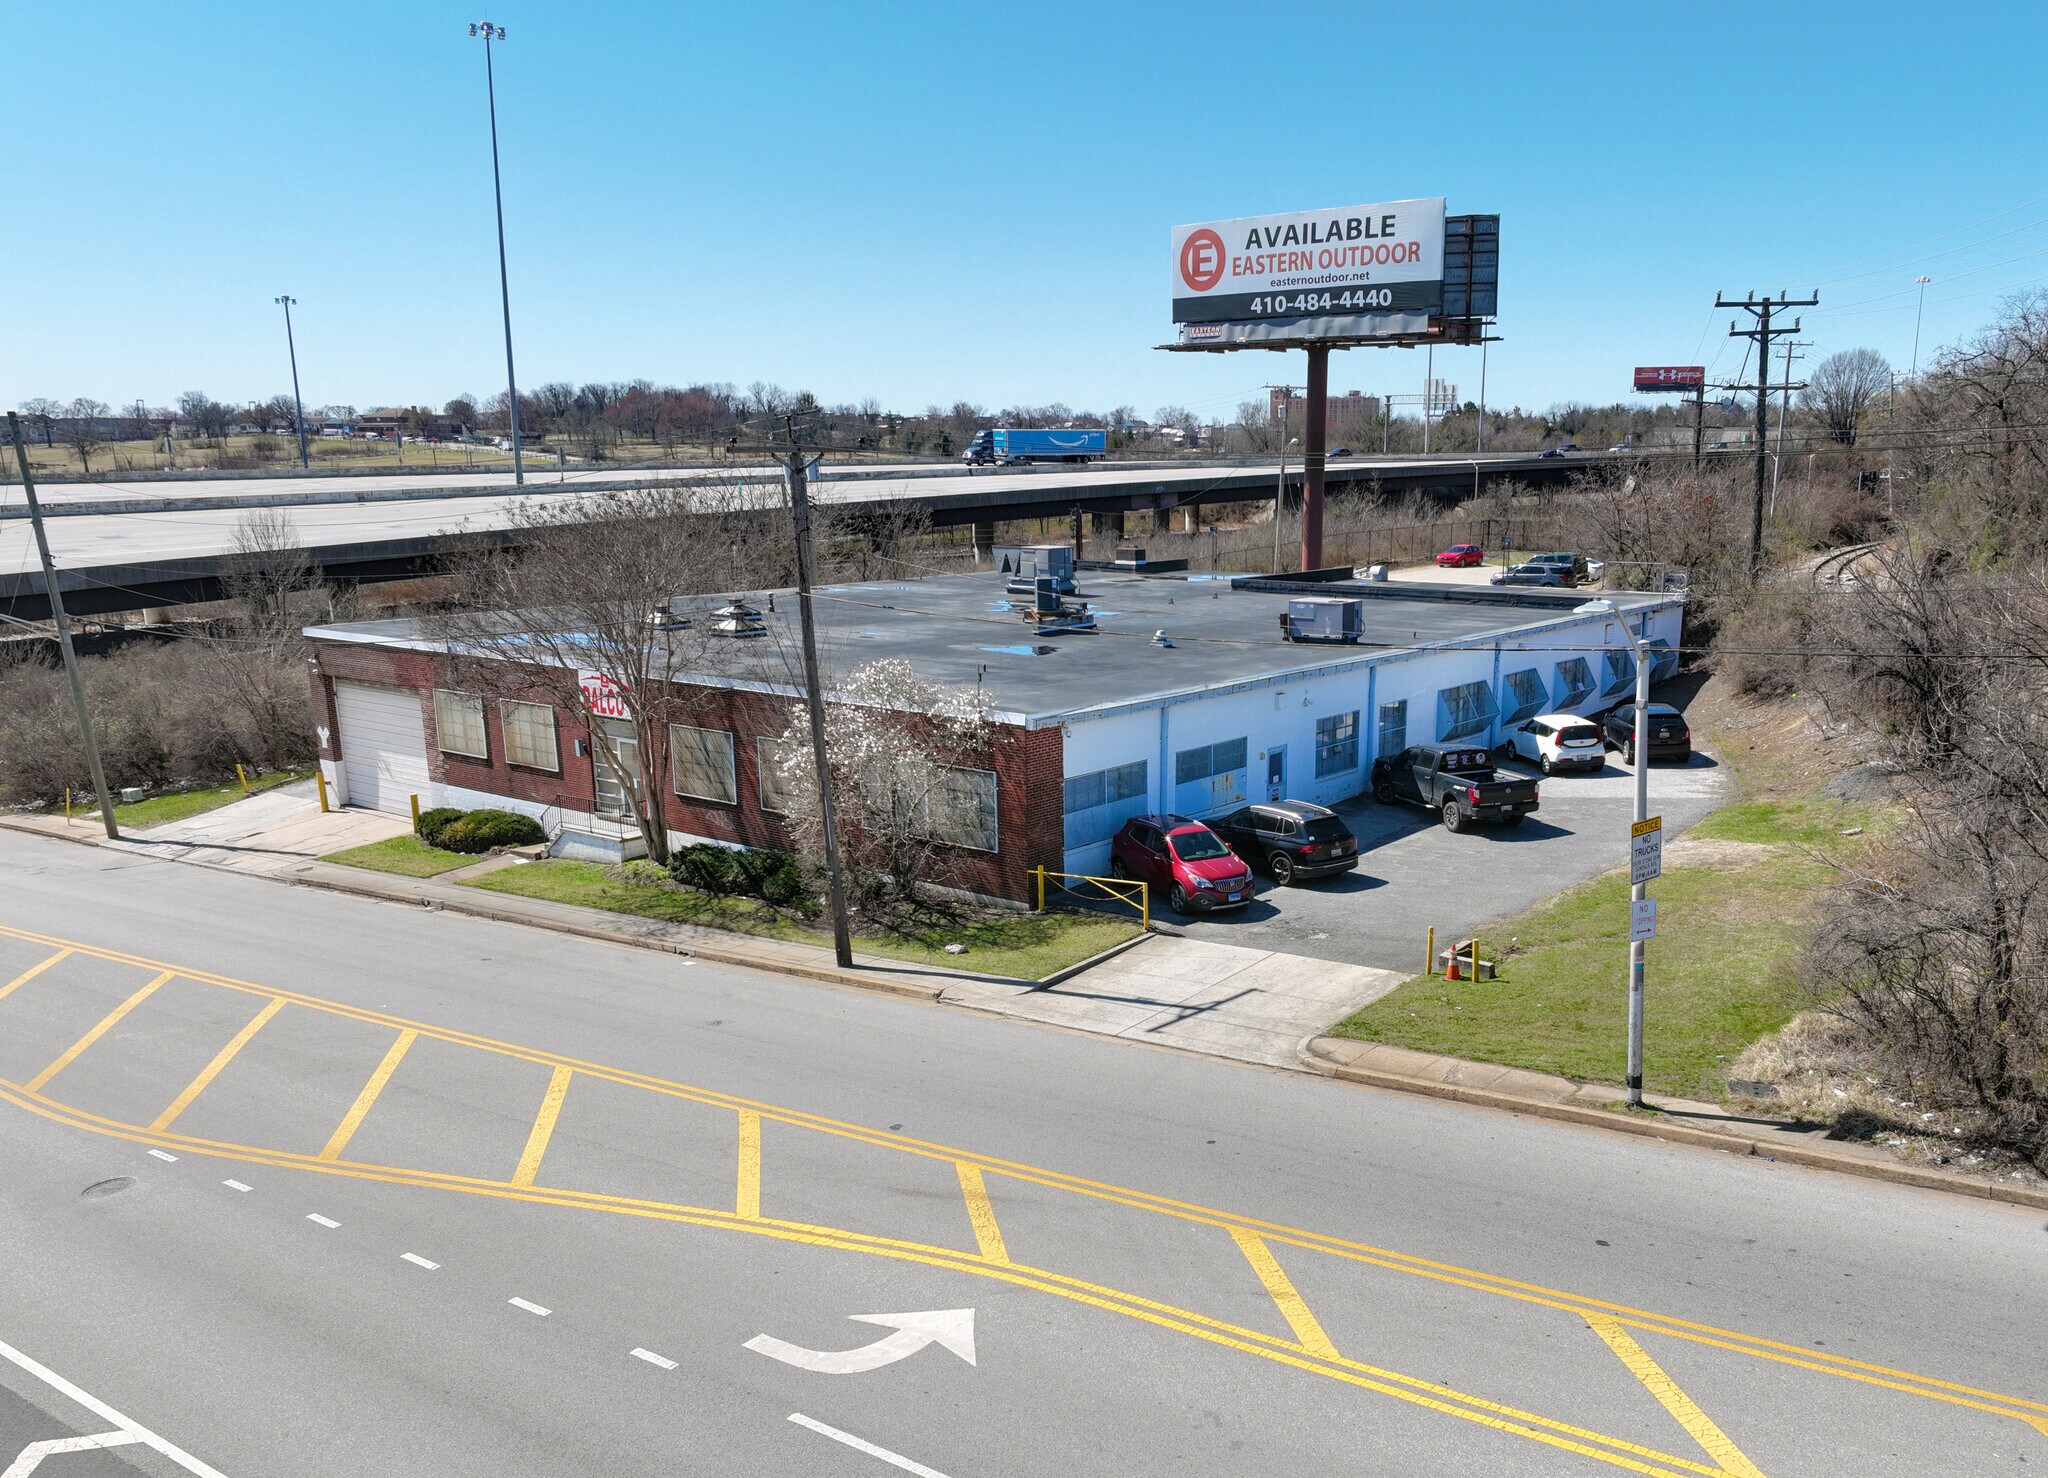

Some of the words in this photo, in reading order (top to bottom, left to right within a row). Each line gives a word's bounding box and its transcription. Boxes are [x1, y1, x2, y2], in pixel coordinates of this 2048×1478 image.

[1245, 215, 1396, 250] AVAILABLE
[1232, 250, 1314, 277] EASTERN
[1318, 241, 1421, 270] OUTDOOR
[1270, 271, 1370, 288] easternoutdoor.net
[1250, 288, 1392, 315] 410-484-4440
[1634, 820, 1659, 835] NOTICE
[1642, 834, 1652, 844] NO
[1634, 843, 1659, 858] TRUCKS
[1639, 904, 1649, 913] NO
